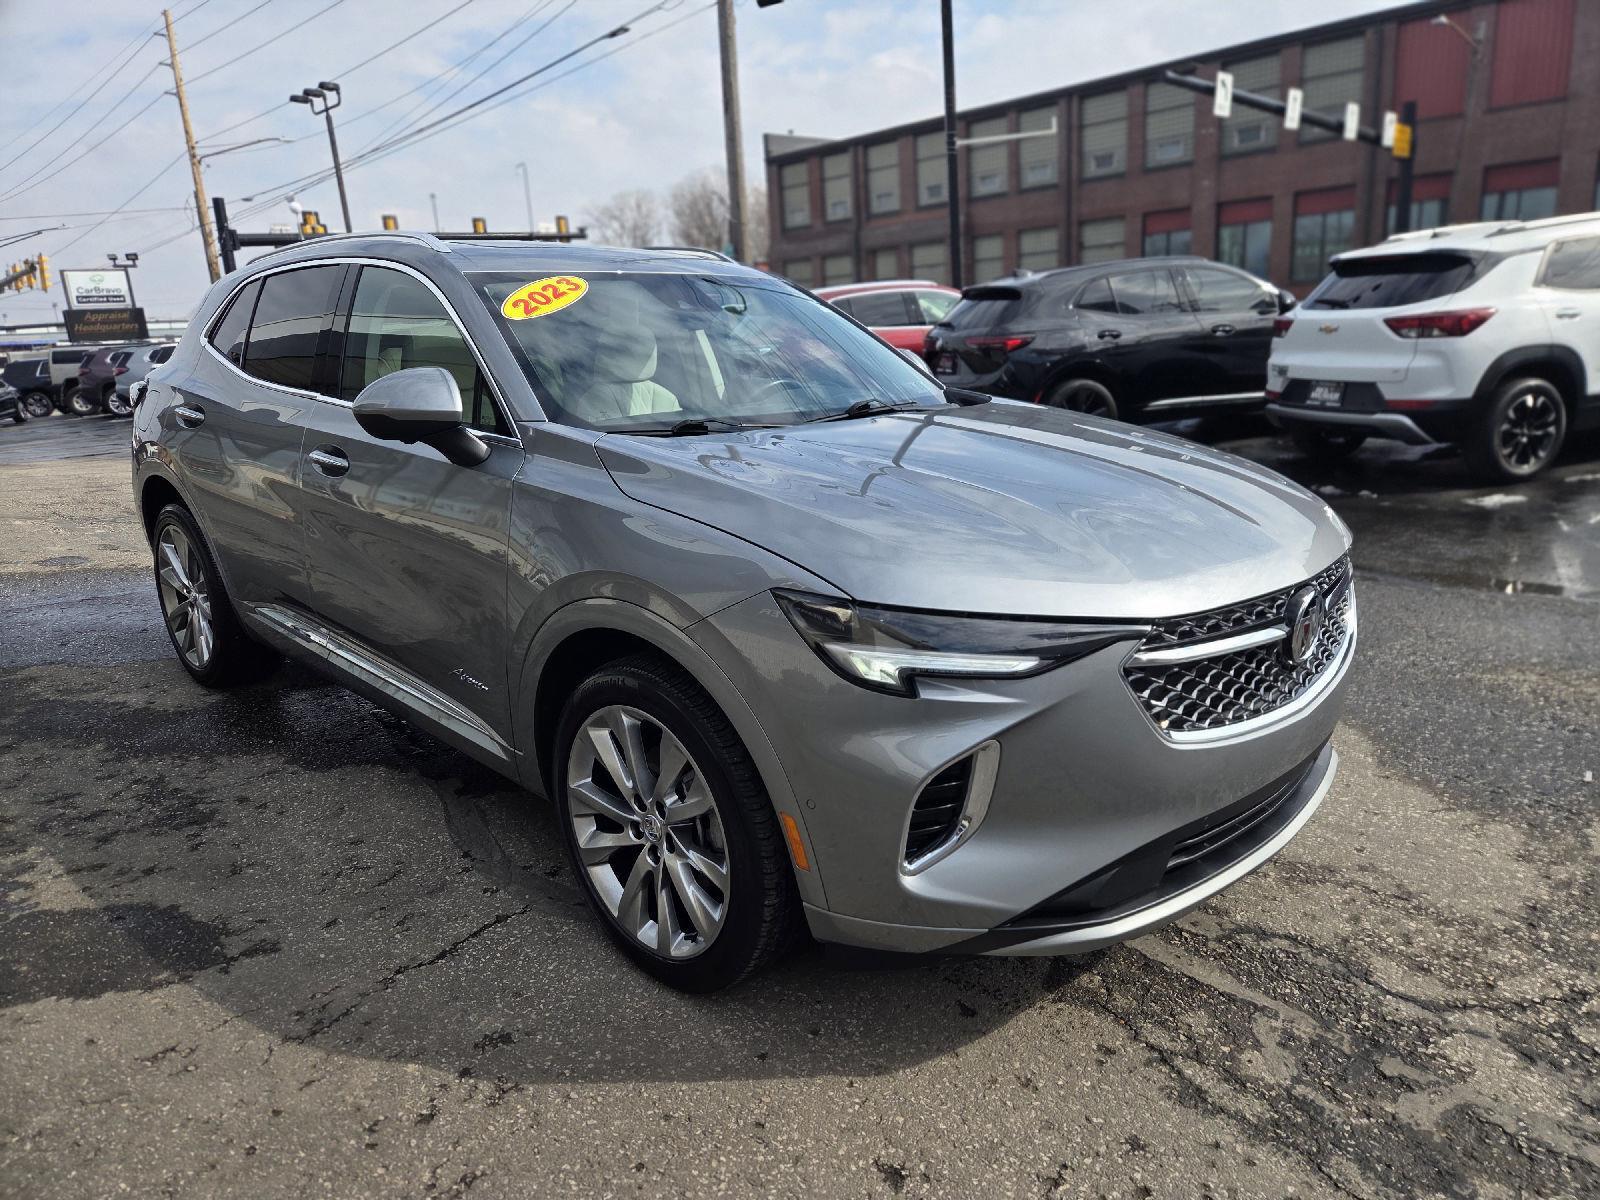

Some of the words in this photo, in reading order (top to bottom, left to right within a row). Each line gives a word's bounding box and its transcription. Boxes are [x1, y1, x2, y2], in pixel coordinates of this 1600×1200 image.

[76, 286, 122, 294] CarBravo
[511, 277, 580, 316] 2023
[84, 311, 129, 321] Appraisal
[75, 323, 138, 333] Headquarters
